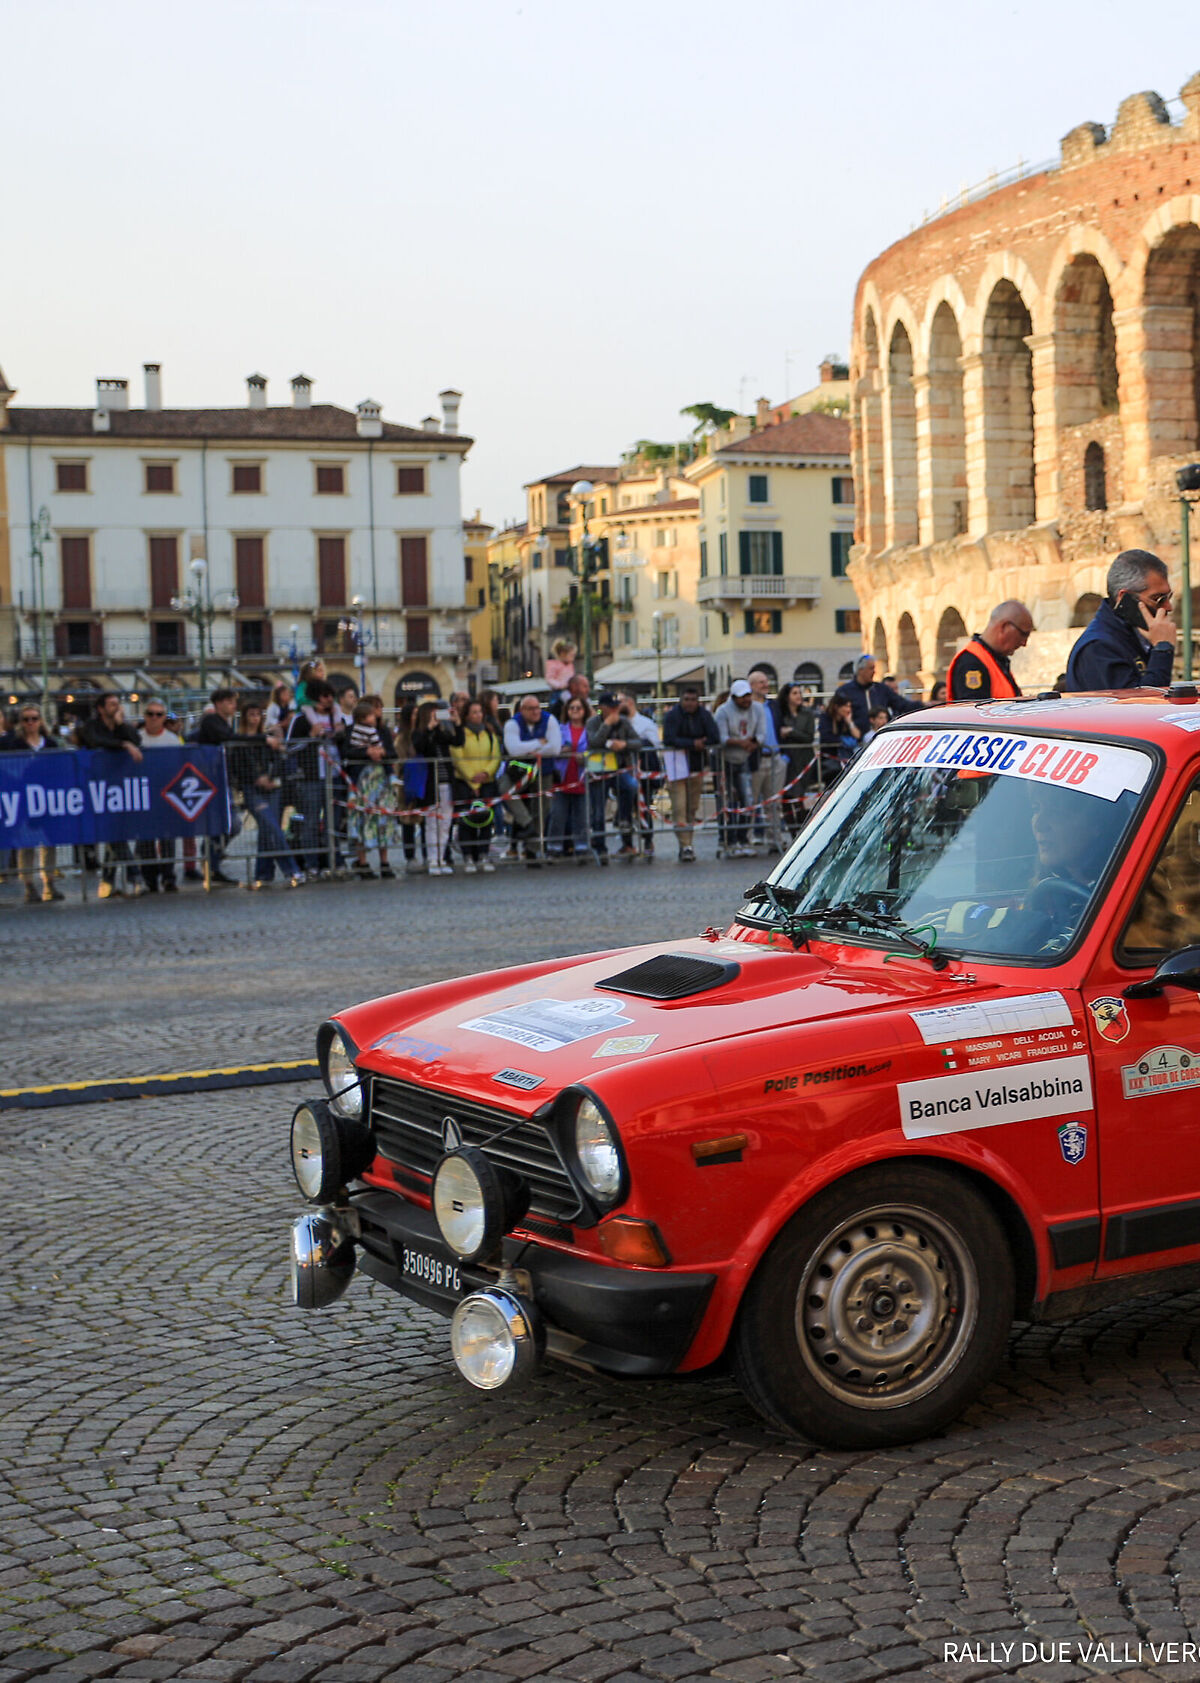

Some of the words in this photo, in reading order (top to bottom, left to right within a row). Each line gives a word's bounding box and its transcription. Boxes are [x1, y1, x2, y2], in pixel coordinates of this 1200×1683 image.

[924, 734, 1028, 771] CLASSIC
[1018, 743, 1099, 785] CLUB
[26, 783, 84, 818] Due
[88, 776, 151, 815] Valli
[965, 1040, 1003, 1053] MASSIMO
[1038, 1030, 1065, 1043] ACQUA
[968, 1055, 991, 1067] MARY
[996, 1050, 1023, 1062] VICARI
[1026, 1043, 1068, 1057] FRAQUELLI
[1158, 1052, 1168, 1068] 4
[497, 1070, 541, 1087] ABARTH
[763, 1076, 799, 1094] Pole
[1148, 1073, 1169, 1087] TOUR
[1169, 1071, 1179, 1083] DE
[909, 1095, 972, 1120] Banca
[975, 1077, 1084, 1109] Valsabbina
[403, 1248, 443, 1285] 350996
[445, 1264, 461, 1291] PG
